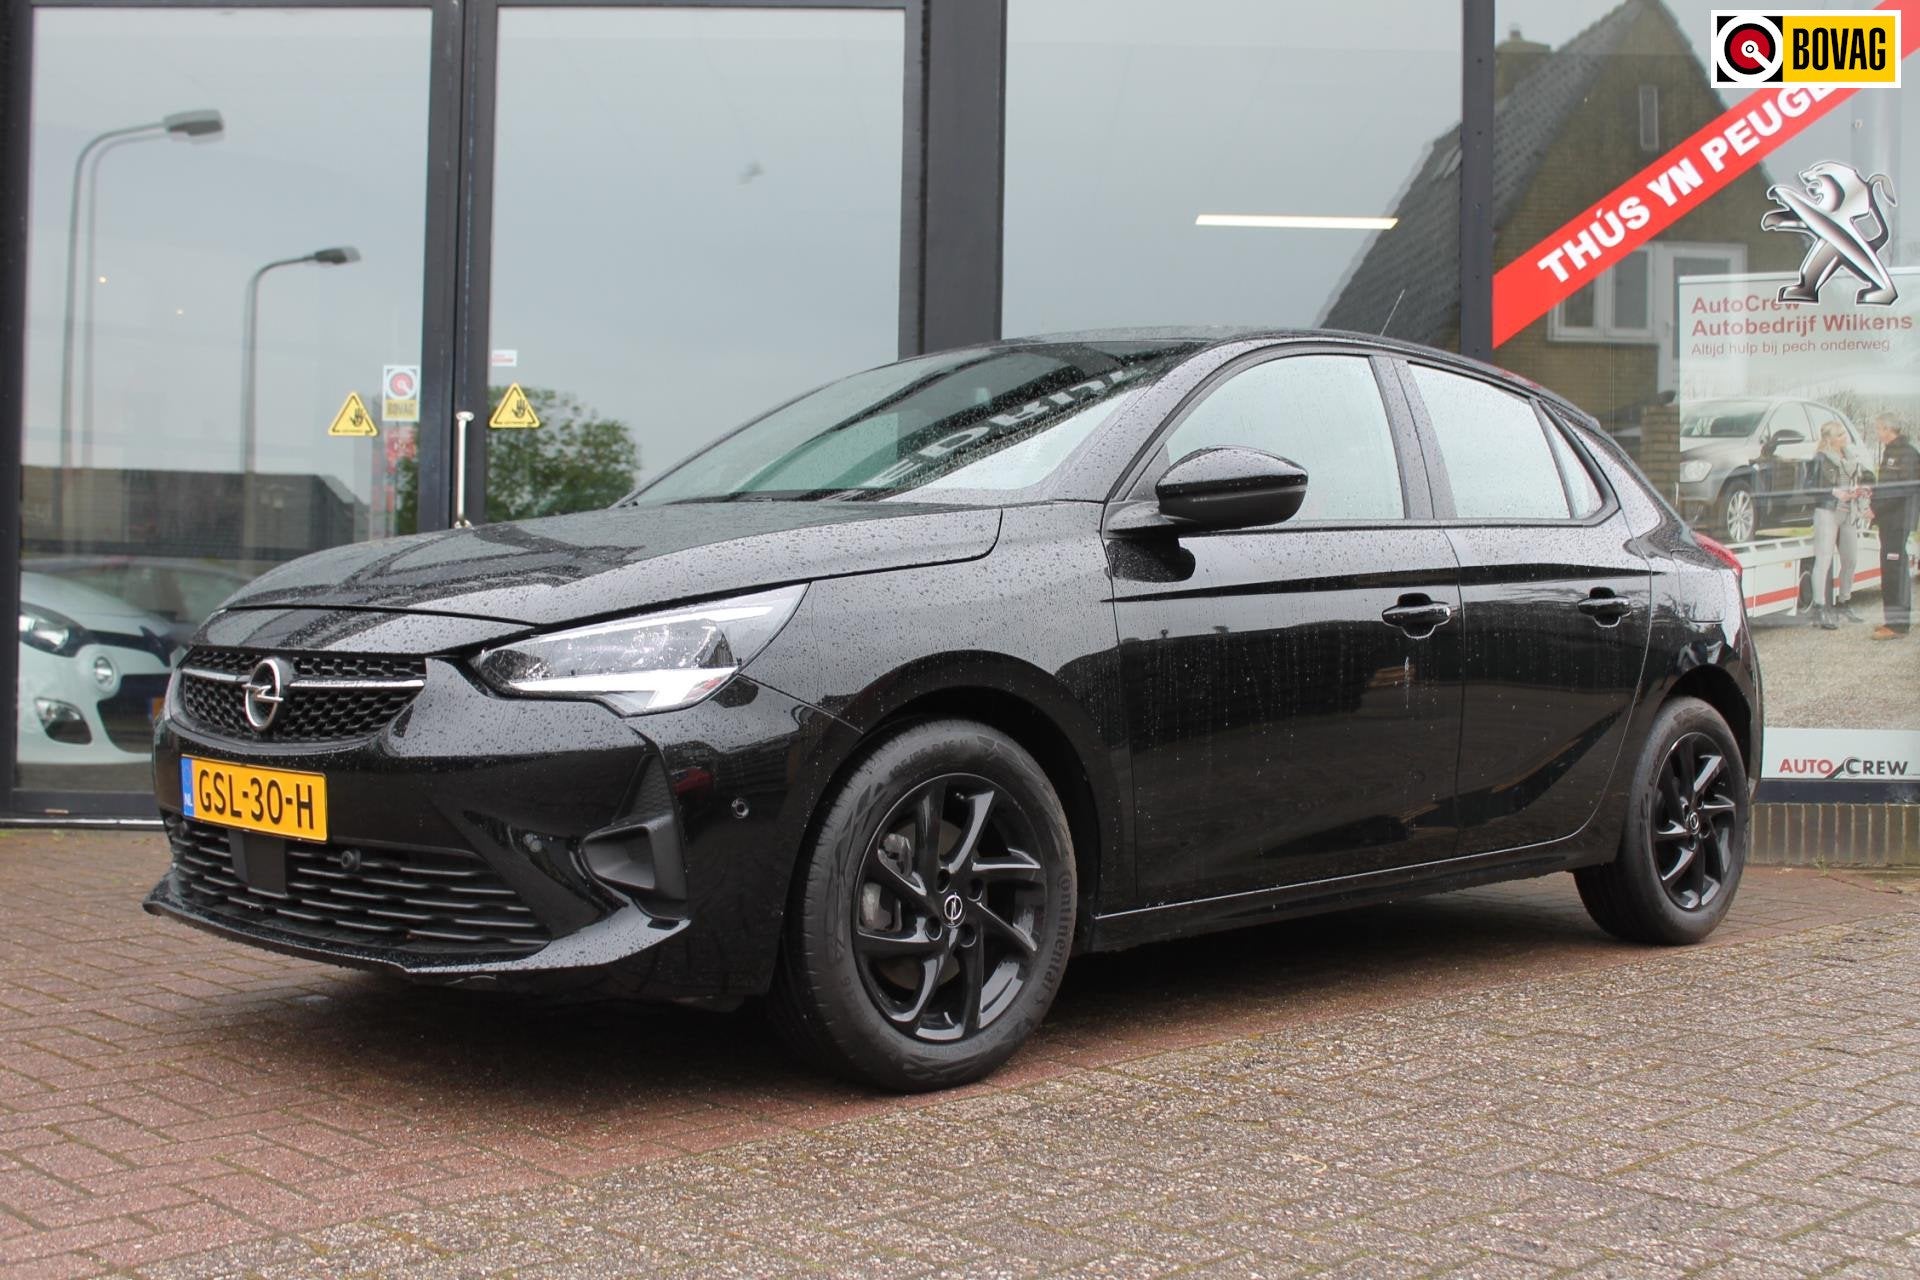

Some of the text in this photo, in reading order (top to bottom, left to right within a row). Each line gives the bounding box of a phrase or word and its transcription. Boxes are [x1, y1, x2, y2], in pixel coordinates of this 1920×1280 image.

[1537, 196, 1650, 282] THÚS
[1647, 157, 1704, 207] YN
[1691, 313, 1913, 337] Autobedrijf Wilkens
[1691, 338, 1890, 358] Altijd hulp bij pech onderweg
[1778, 757, 1908, 776] AUTO CREW
[183, 793, 193, 807] NL
[199, 769, 314, 830] GSL-30-H
